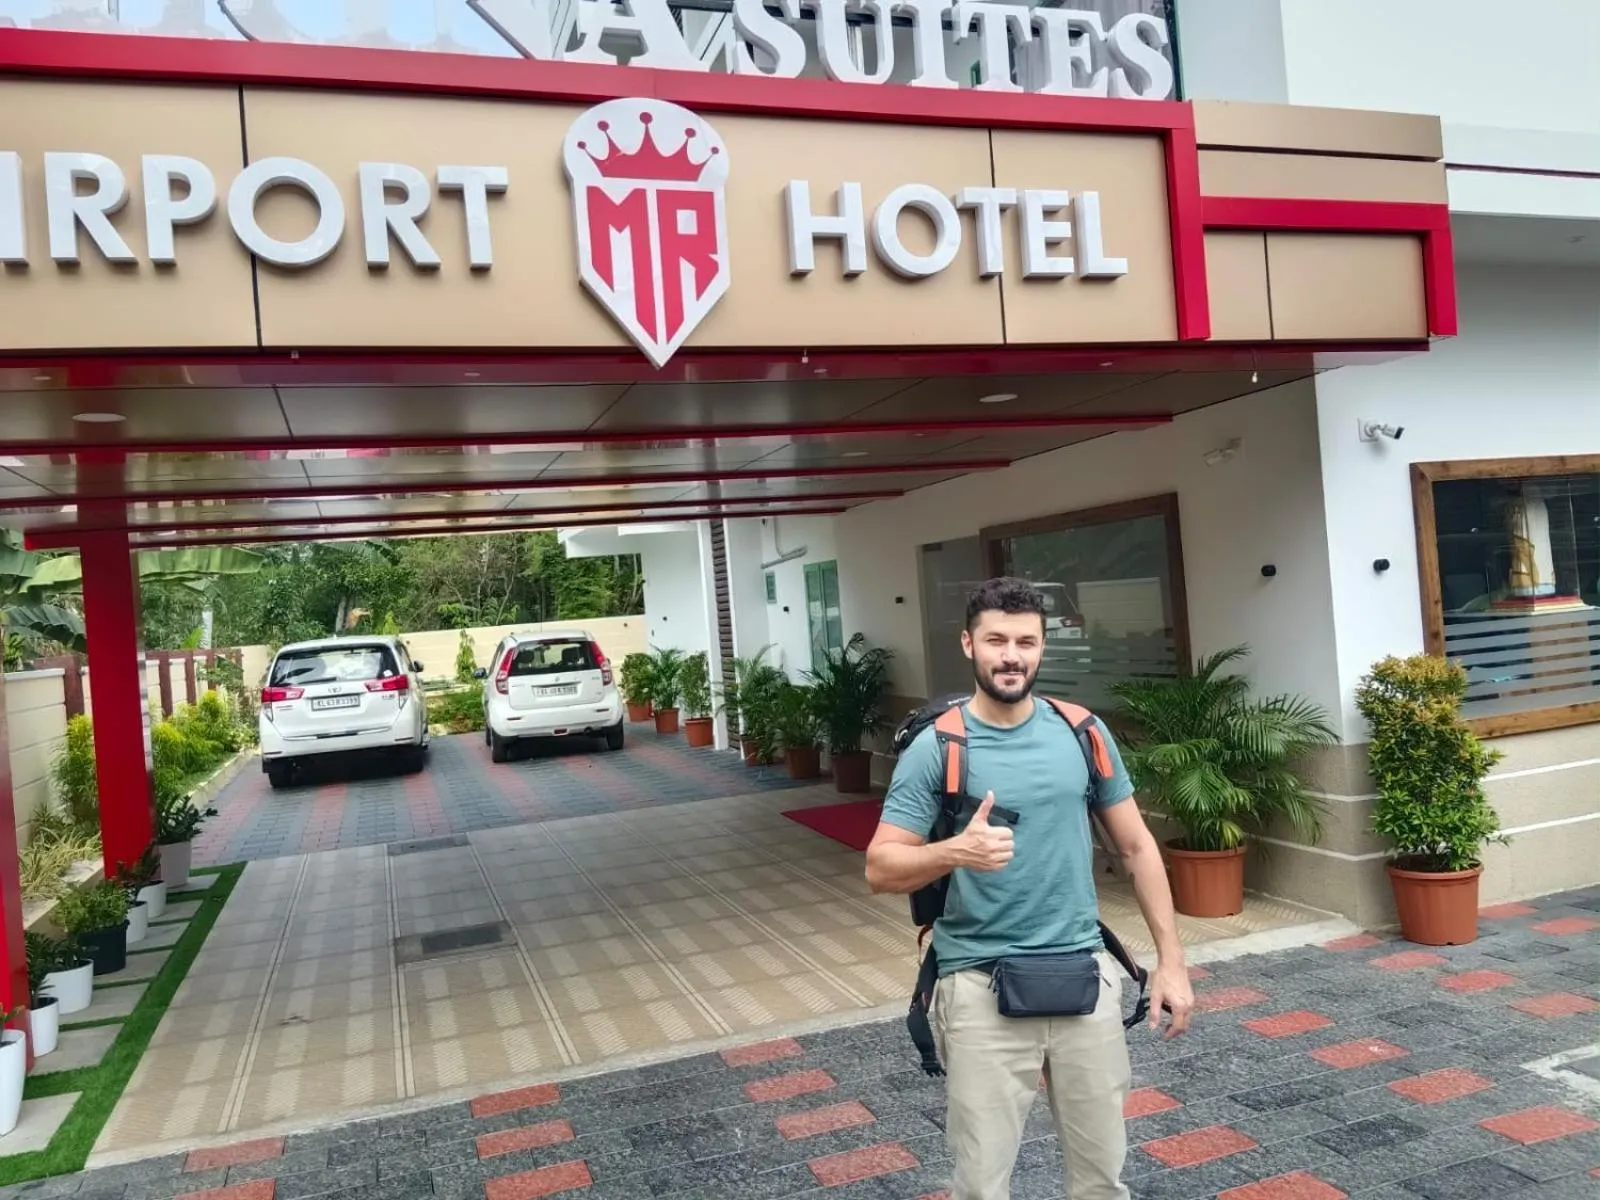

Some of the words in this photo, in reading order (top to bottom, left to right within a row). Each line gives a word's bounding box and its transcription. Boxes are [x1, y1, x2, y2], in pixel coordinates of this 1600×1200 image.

[725, 0, 1174, 101] SUITES
[586, 186, 719, 345] MR
[786, 180, 1128, 280] HOTEL
